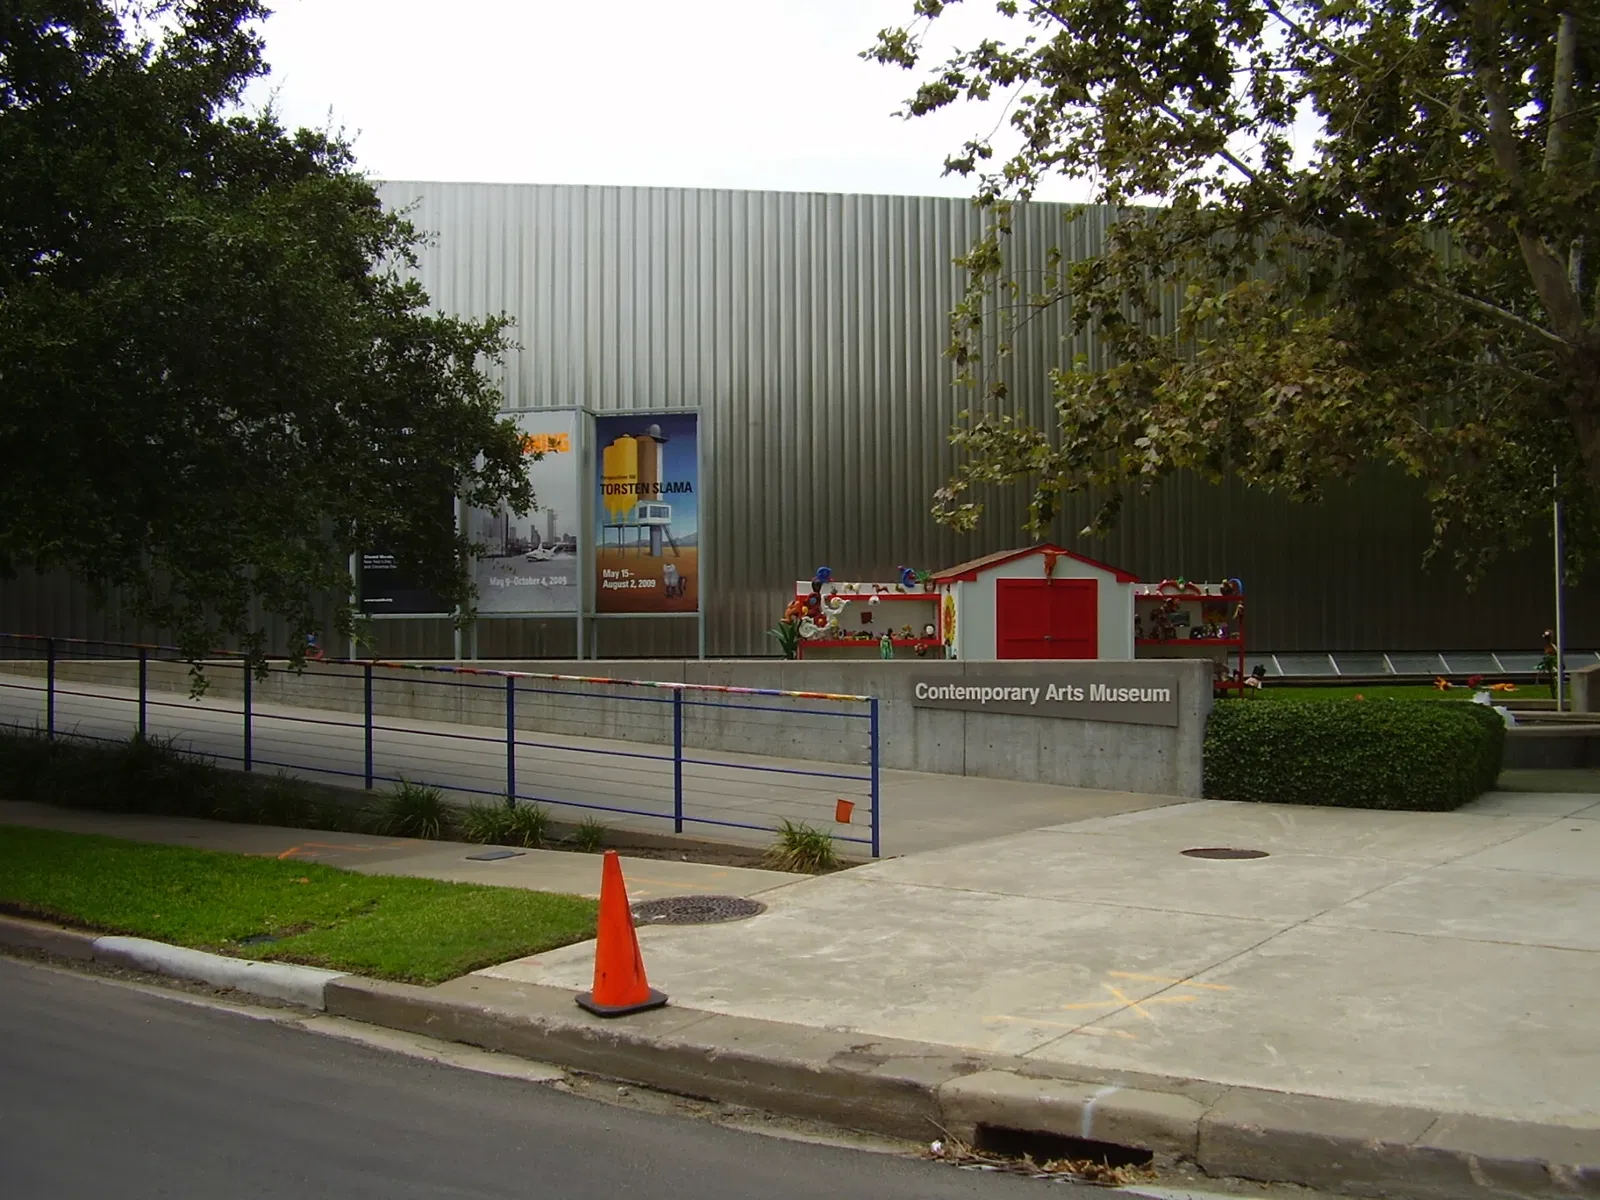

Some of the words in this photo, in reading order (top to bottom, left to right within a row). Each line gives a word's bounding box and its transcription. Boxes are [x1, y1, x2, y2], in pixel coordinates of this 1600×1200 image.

[600, 482, 649, 495] TORSTEN
[652, 480, 693, 494] SLAMA
[602, 569, 619, 579] May
[489, 576, 504, 588] May
[549, 576, 567, 586] 2009
[602, 580, 629, 590] August
[630, 579, 637, 589] 2,
[638, 579, 656, 588] 2009
[914, 681, 1040, 705] Contemporary
[1045, 683, 1084, 702] Arts
[1089, 683, 1171, 703] Museum
